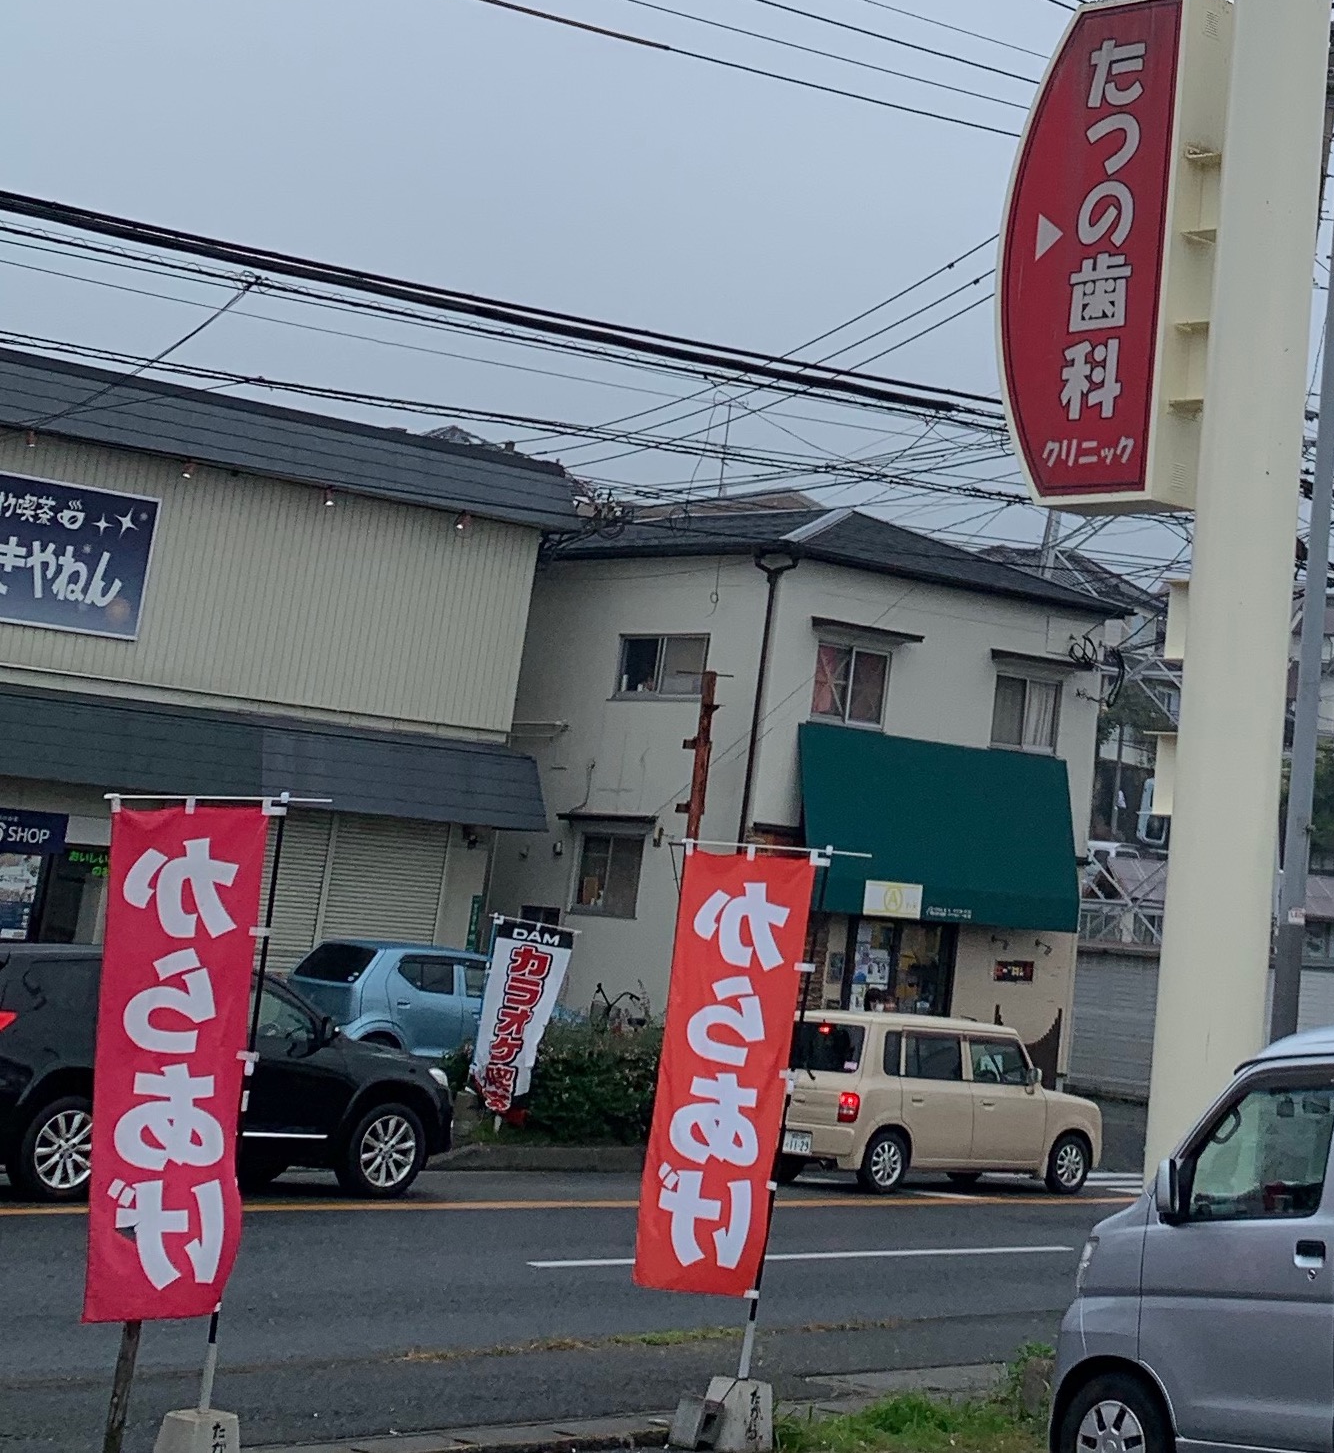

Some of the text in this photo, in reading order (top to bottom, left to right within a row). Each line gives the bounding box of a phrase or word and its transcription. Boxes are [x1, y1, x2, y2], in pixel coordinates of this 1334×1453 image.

[1058, 38, 1147, 422] たつの歯科
[1041, 435, 1135, 469] クリニック
[7, 825, 51, 845] SHOP
[512, 927, 561, 947] DAM
